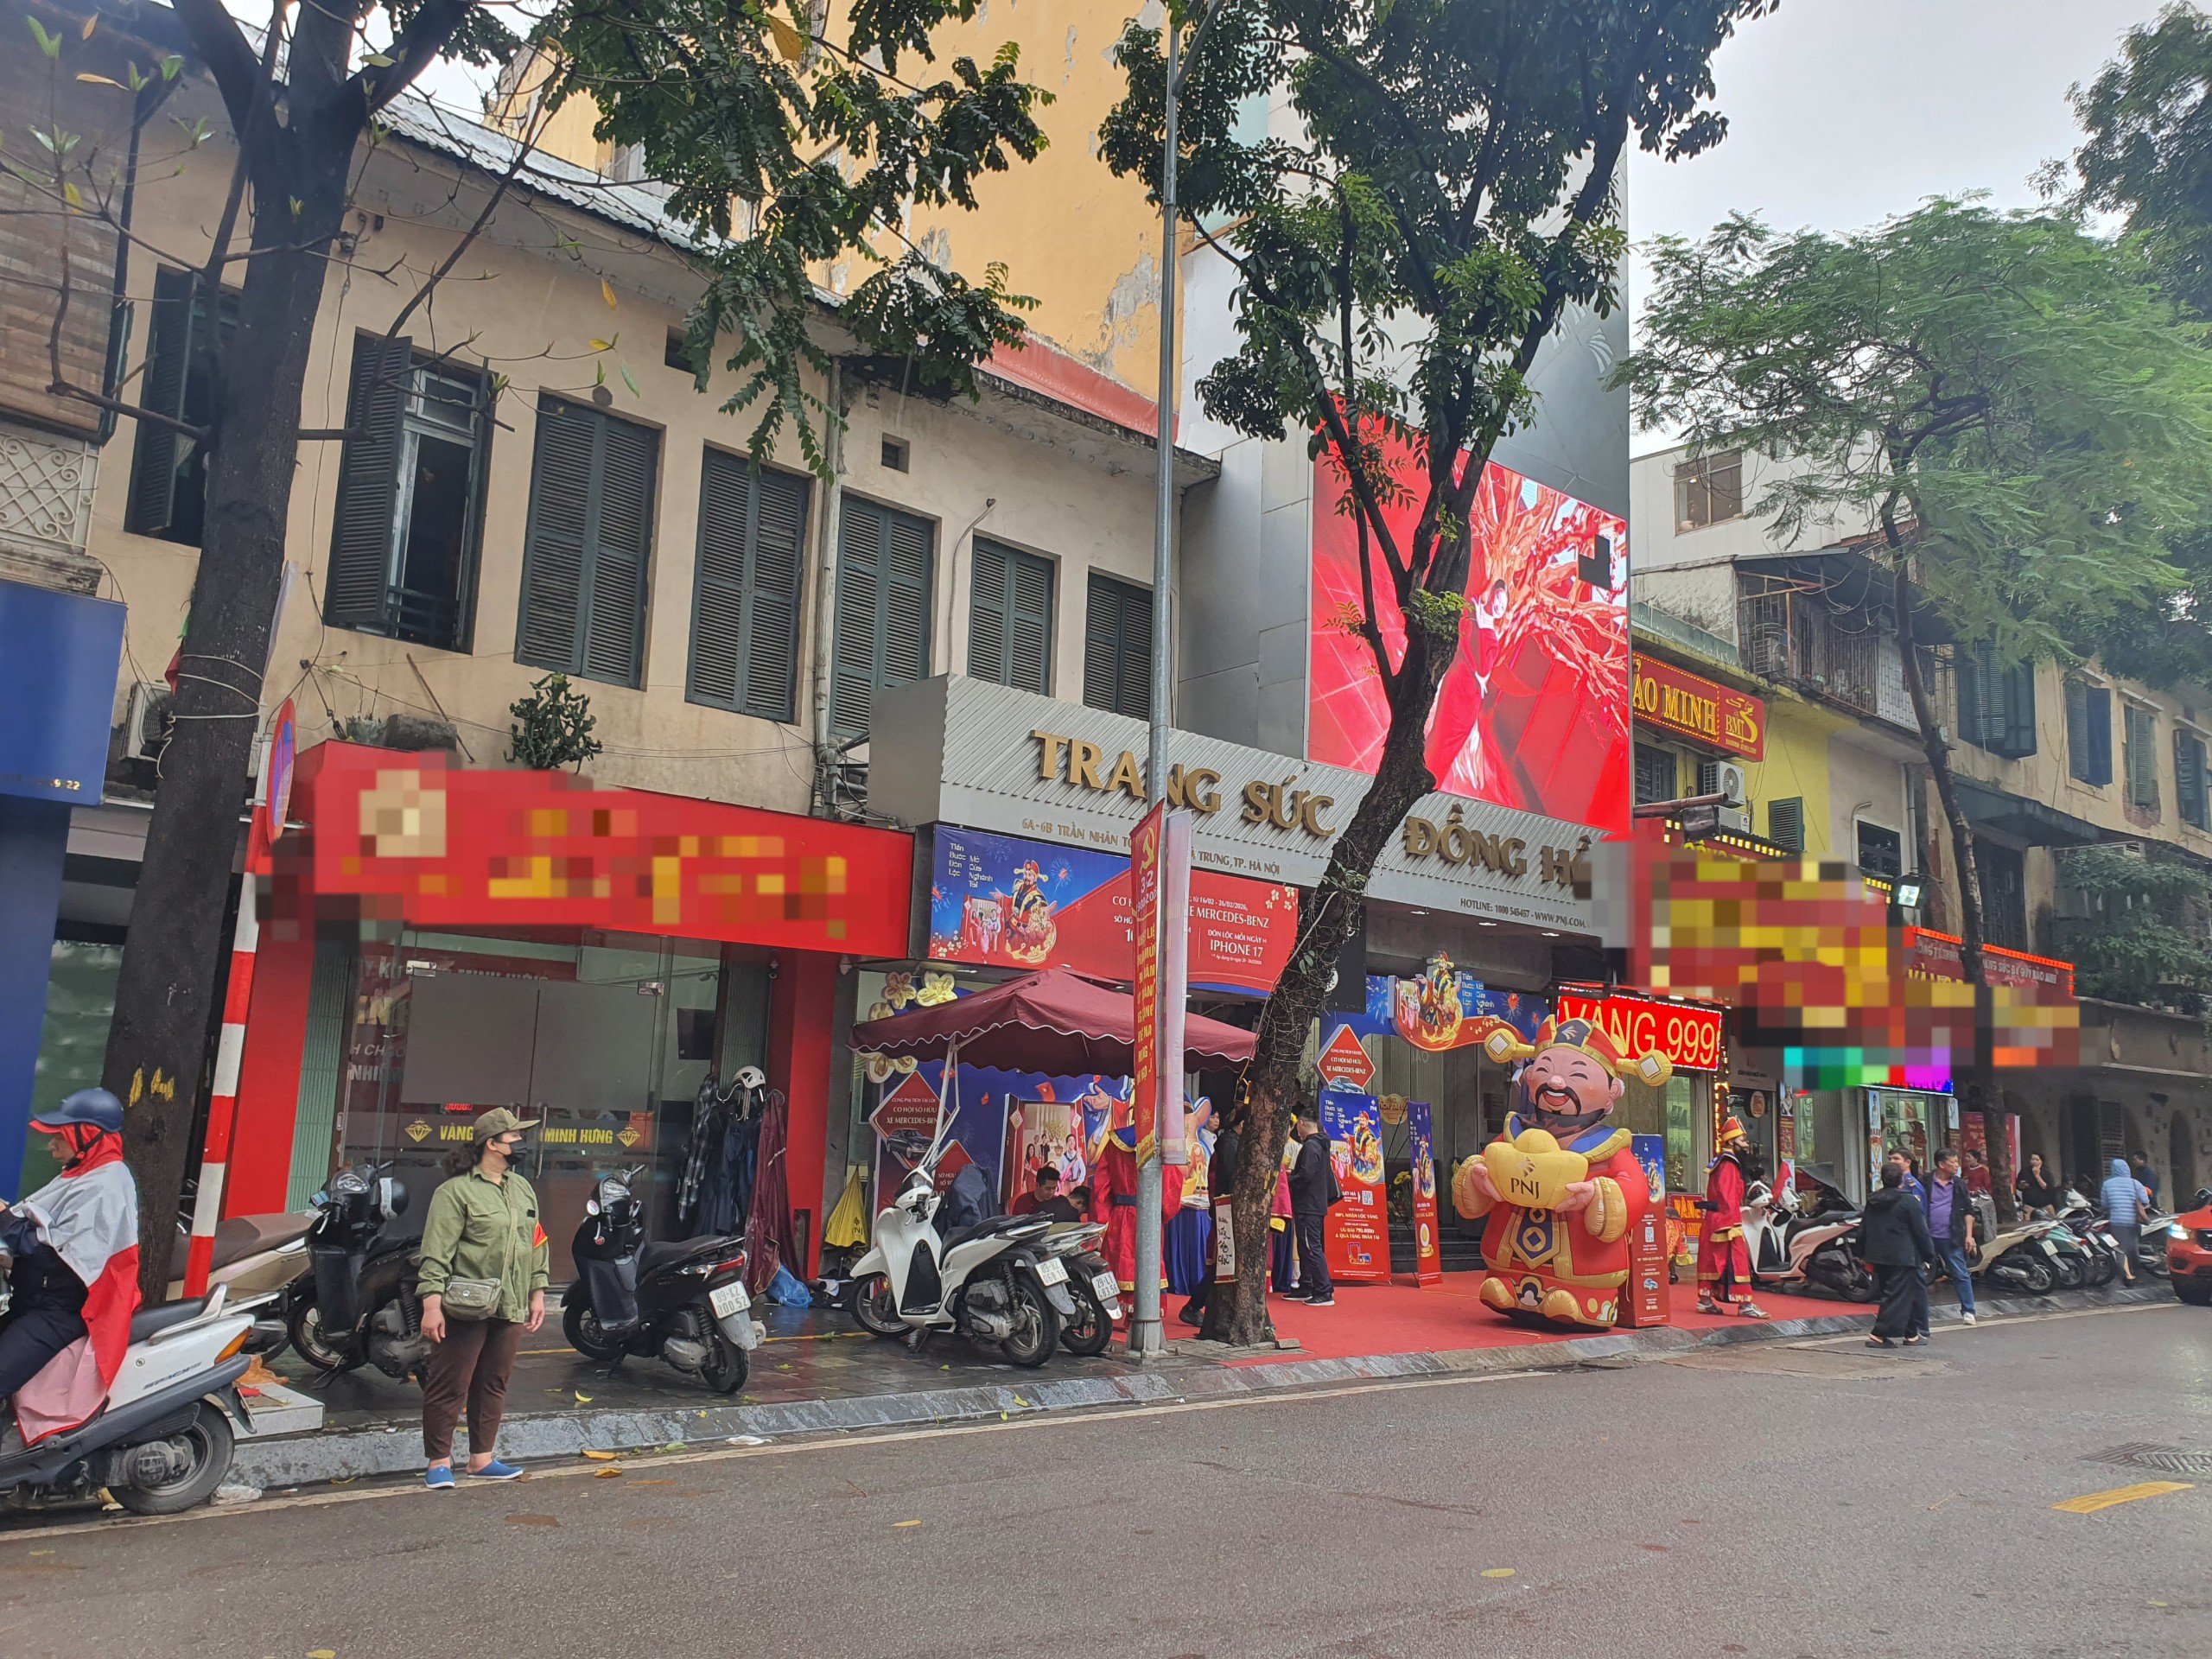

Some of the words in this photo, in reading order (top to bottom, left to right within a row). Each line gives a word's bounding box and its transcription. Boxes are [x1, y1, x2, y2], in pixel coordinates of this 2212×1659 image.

[1663, 684, 1719, 736] MINH
[1031, 729, 1222, 812] TRANG
[1243, 775, 1337, 837] SỨC
[1403, 803, 1528, 875] ĐỒNG
[1058, 821, 1084, 840] TRẦN
[1089, 829, 1118, 846] NHÂN
[1249, 859, 1262, 872] HÀ
[1264, 861, 1280, 876] NỘI
[1112, 895, 1127, 906] CƠ
[1460, 898, 1493, 912] HOTLINE:
[1197, 907, 1269, 929] MERCEDES-BENZ
[1208, 929, 1221, 938] ĐÓN
[1222, 931, 1234, 939] LỘC
[1247, 935, 1262, 944] NGÀY
[1211, 939, 1251, 956] IPHONE
[1252, 946, 1263, 957] 17
[1998, 958, 2011, 974] SỨC
[1666, 1017, 1715, 1065] 999
[1332, 1065, 1366, 1075] MERCEDES-BENZ
[129, 1066, 175, 1108] 14
[904, 1105, 914, 1114] HỘI
[440, 1122, 474, 1141] VÀNG
[544, 1128, 577, 1143] MINH
[580, 1127, 613, 1144] HƯNG
[1510, 1177, 1540, 1199] PNJ
[715, 1285, 741, 1303] 89-K2
[716, 1295, 748, 1316] 000.52
